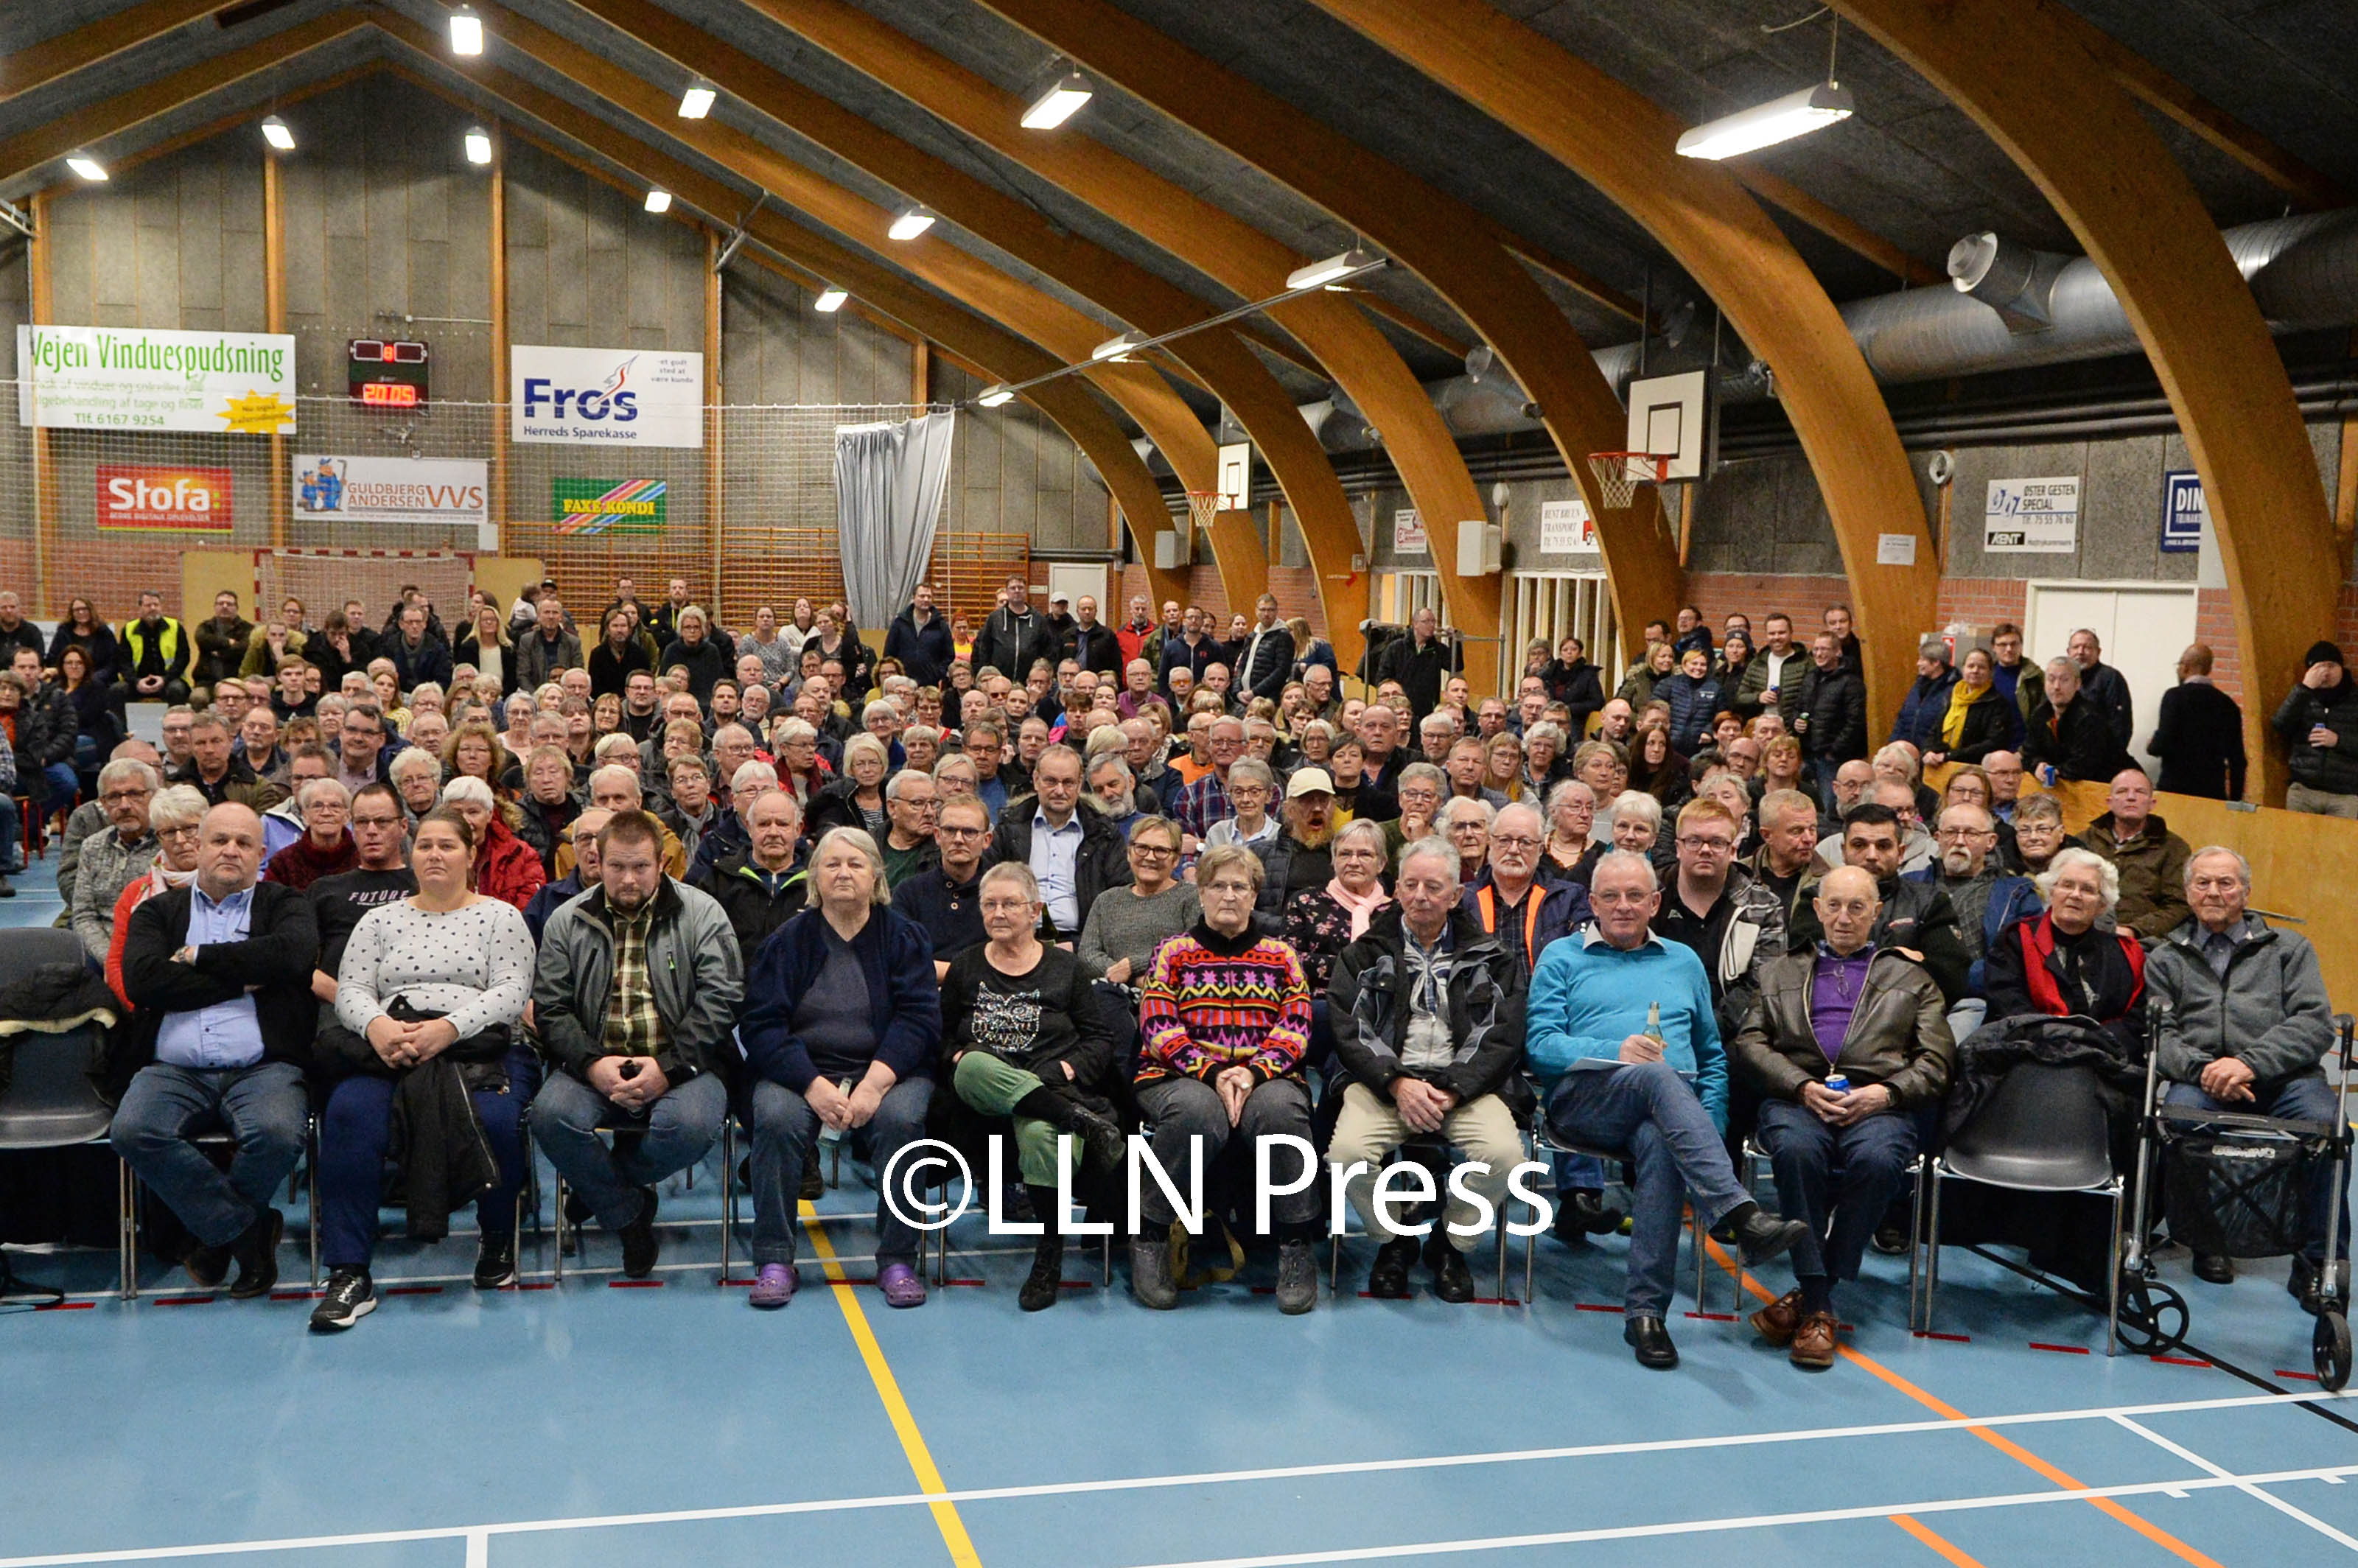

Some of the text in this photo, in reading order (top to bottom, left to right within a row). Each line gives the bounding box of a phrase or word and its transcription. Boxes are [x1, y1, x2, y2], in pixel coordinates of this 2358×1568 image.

[97, 334, 284, 382] Vinduespudsning
[97, 413, 128, 425] 6167
[133, 414, 165, 426] 9254
[524, 425, 637, 440] Herreds Sparekasse
[348, 482, 425, 496] GULDBJERG
[2048, 484, 2076, 496] GESTEN
[348, 494, 425, 508] ANDERSEN
[426, 485, 483, 509] VVS
[563, 498, 655, 515] FAXE KONDI
[2023, 499, 2054, 511] SPECIAL
[348, 889, 410, 903] FUTURE
